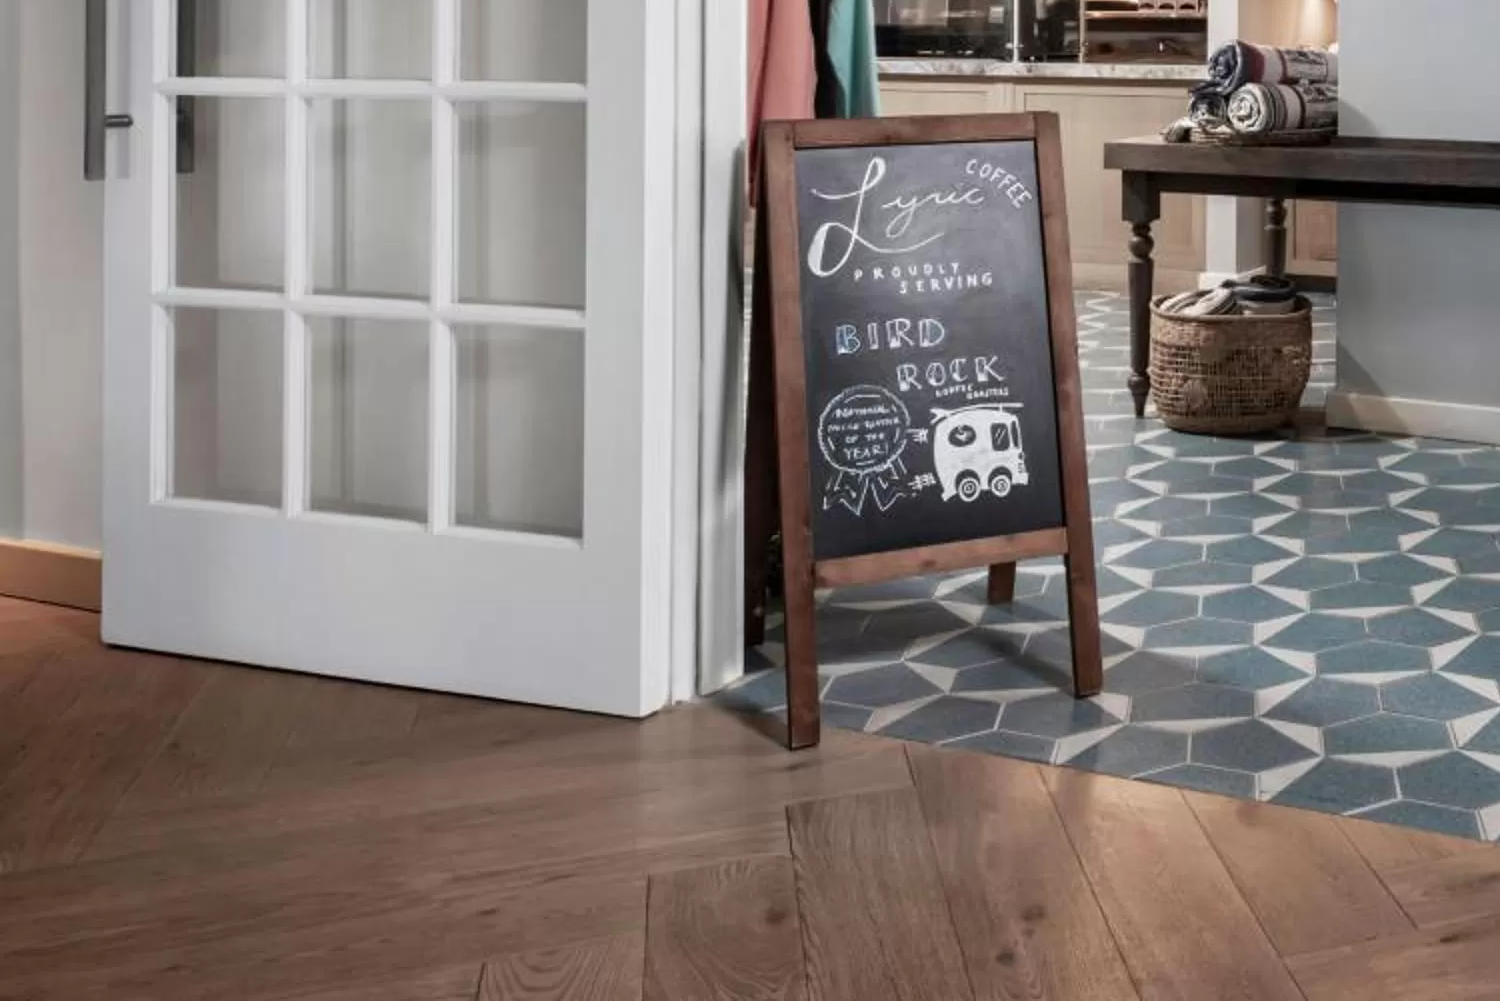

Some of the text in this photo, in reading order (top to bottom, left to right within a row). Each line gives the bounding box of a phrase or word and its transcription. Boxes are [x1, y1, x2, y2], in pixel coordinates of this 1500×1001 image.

[965, 158, 1033, 209] COFFEE
[807, 156, 986, 278] Lyric
[853, 261, 961, 282] PROUDLY
[898, 271, 994, 295] SERVING
[834, 317, 947, 356] BIRD
[895, 354, 1007, 392] ROCK
